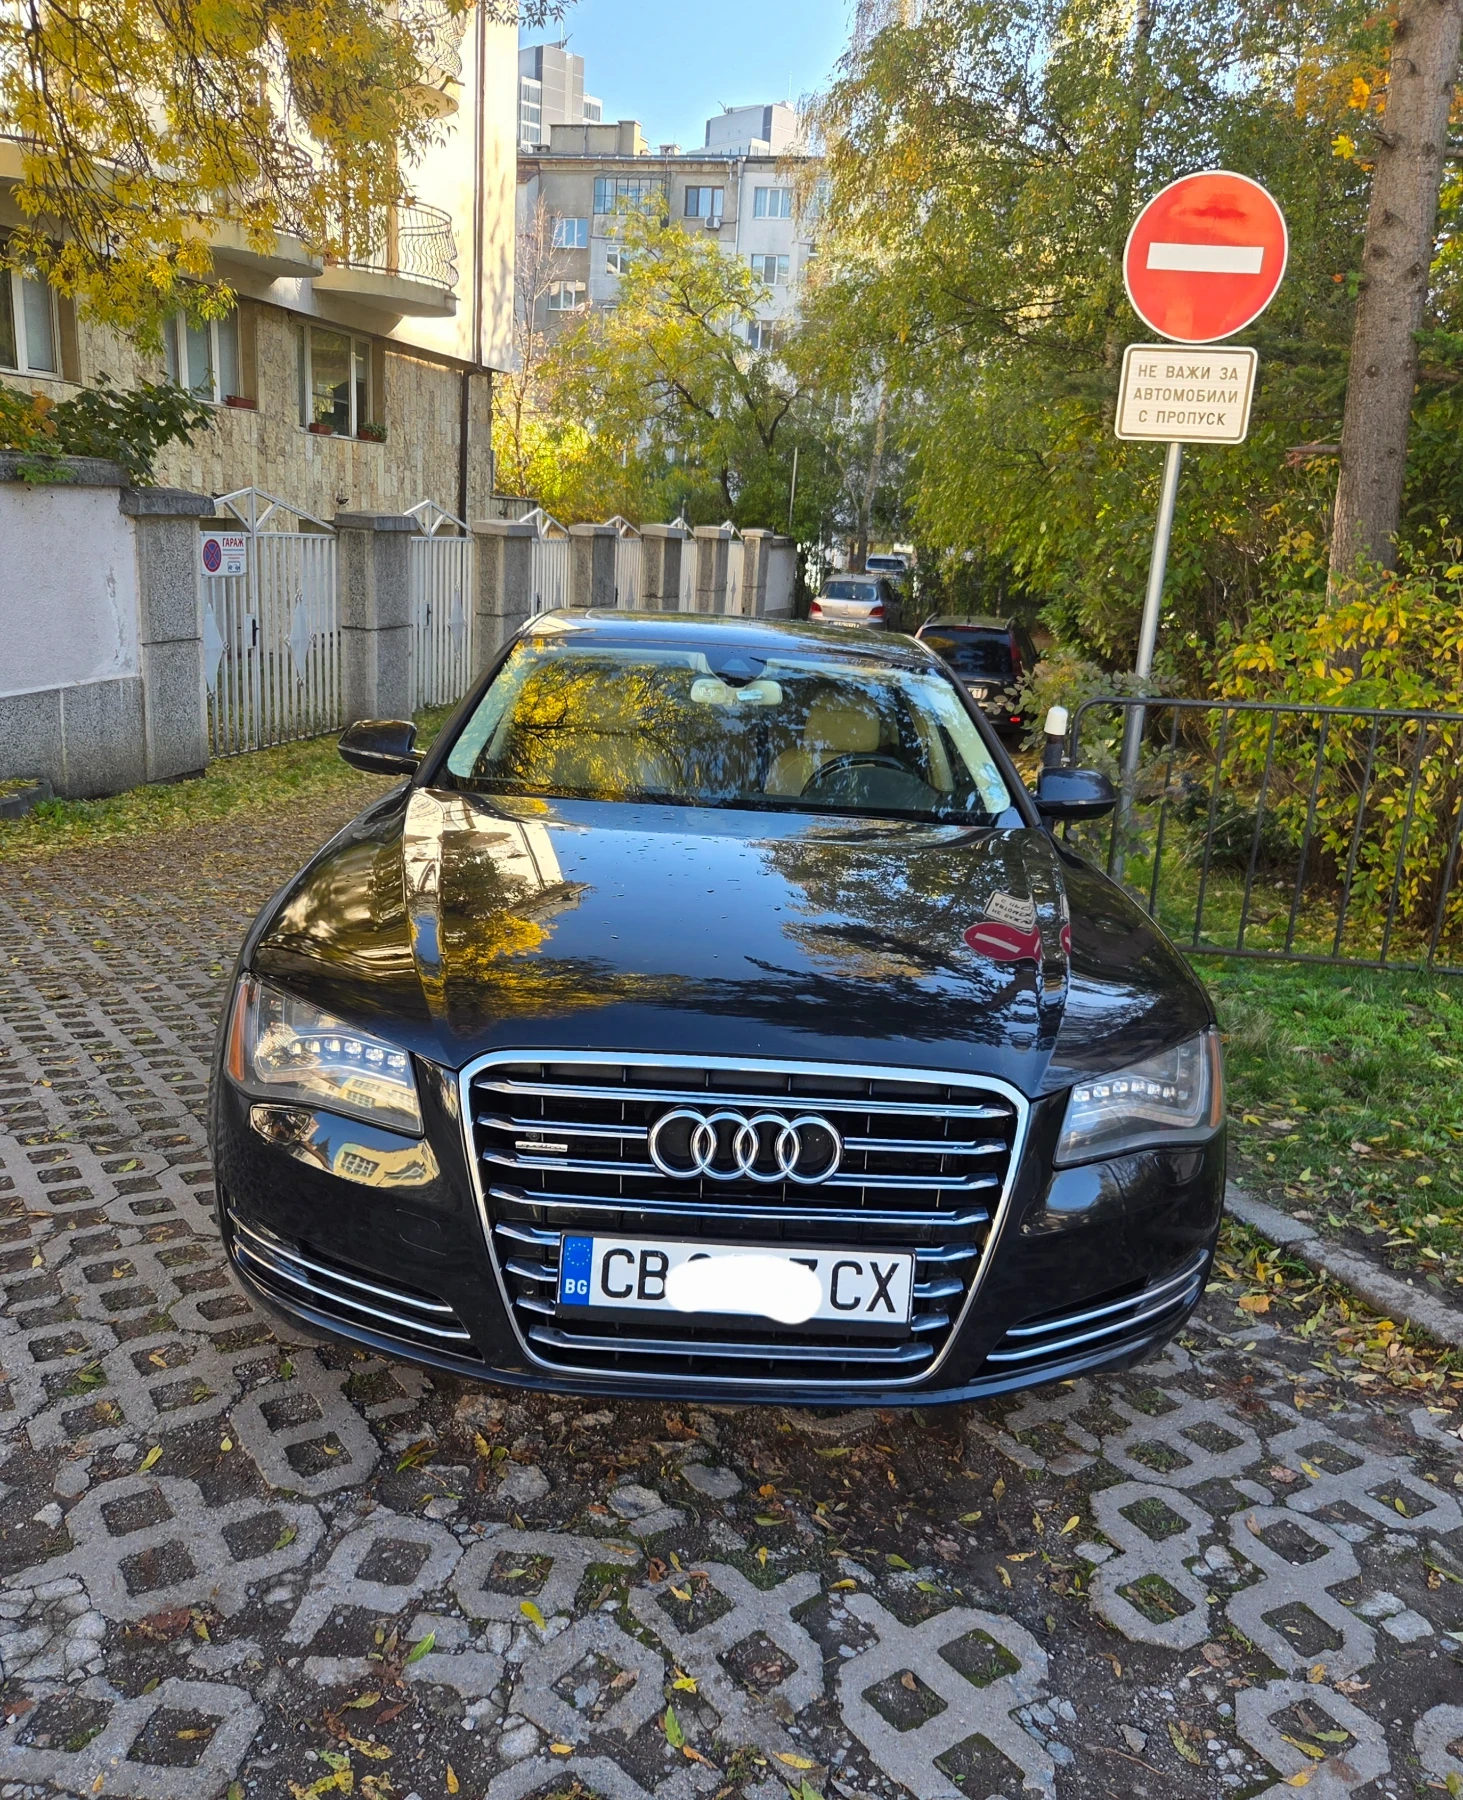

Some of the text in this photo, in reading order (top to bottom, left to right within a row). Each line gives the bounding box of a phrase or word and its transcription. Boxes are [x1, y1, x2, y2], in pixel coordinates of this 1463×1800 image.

[1138, 365, 1238, 381] НЕ ВАЖИ ЗА
[1133, 387, 1238, 404] АВТОМОБИЛИ
[1138, 410, 1226, 426] С ПРОПУСК
[222, 537, 245, 548] ГАРАЖ
[564, 1279, 588, 1295] BG
[829, 1260, 900, 1313] CX
